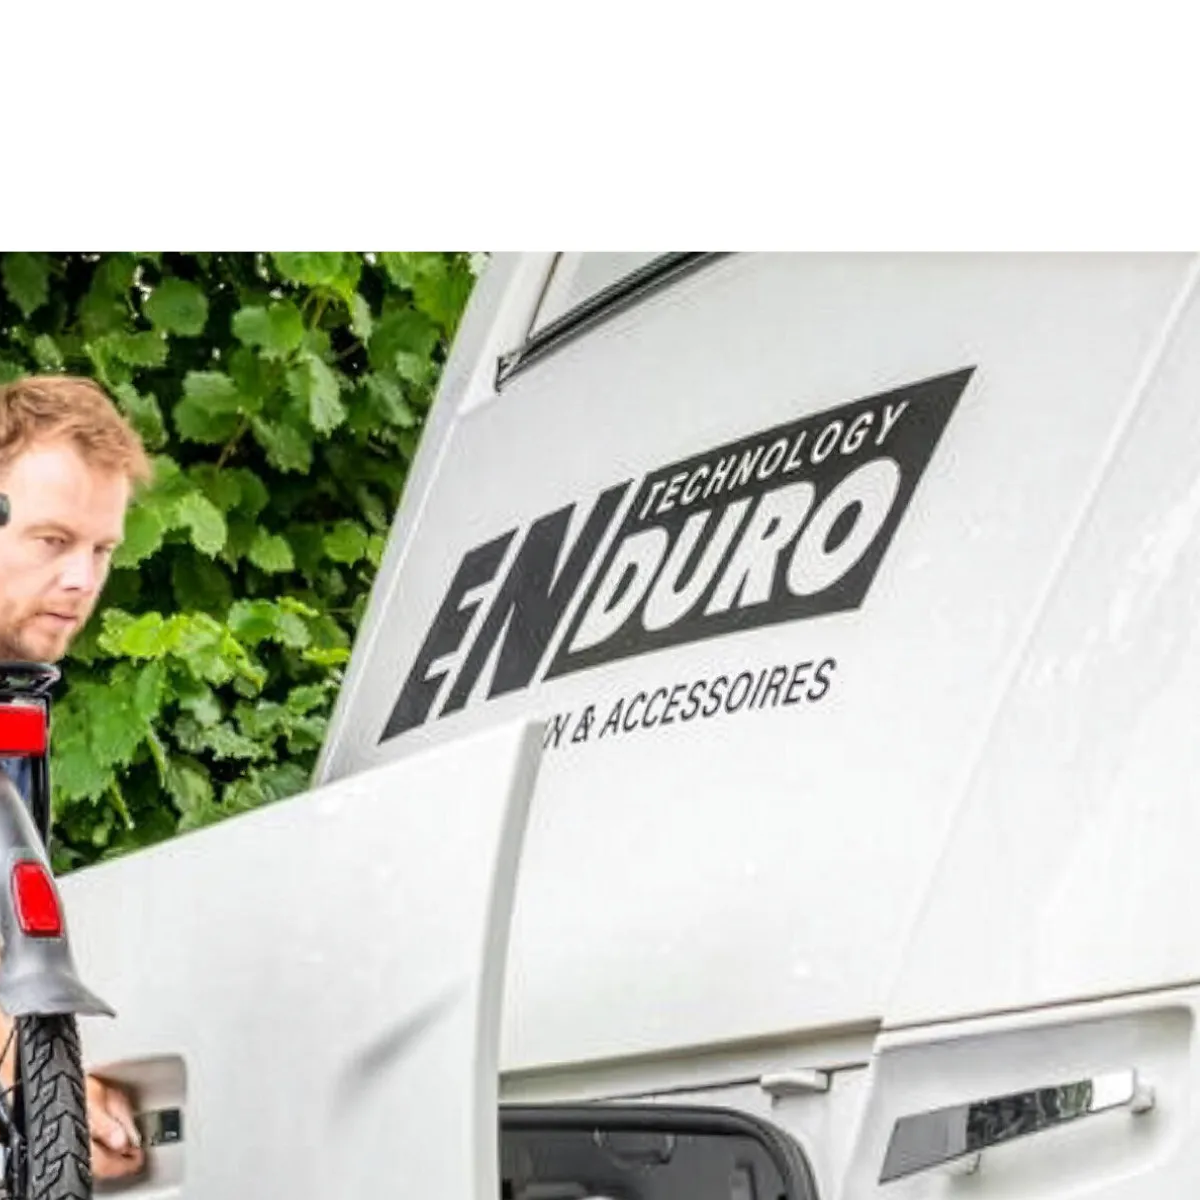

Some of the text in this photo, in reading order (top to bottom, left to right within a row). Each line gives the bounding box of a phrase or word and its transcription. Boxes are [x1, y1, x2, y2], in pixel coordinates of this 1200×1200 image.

[640, 400, 909, 521] TECHNOLOGY
[571, 704, 596, 743] &
[598, 657, 838, 739] ACCESSOIRES
